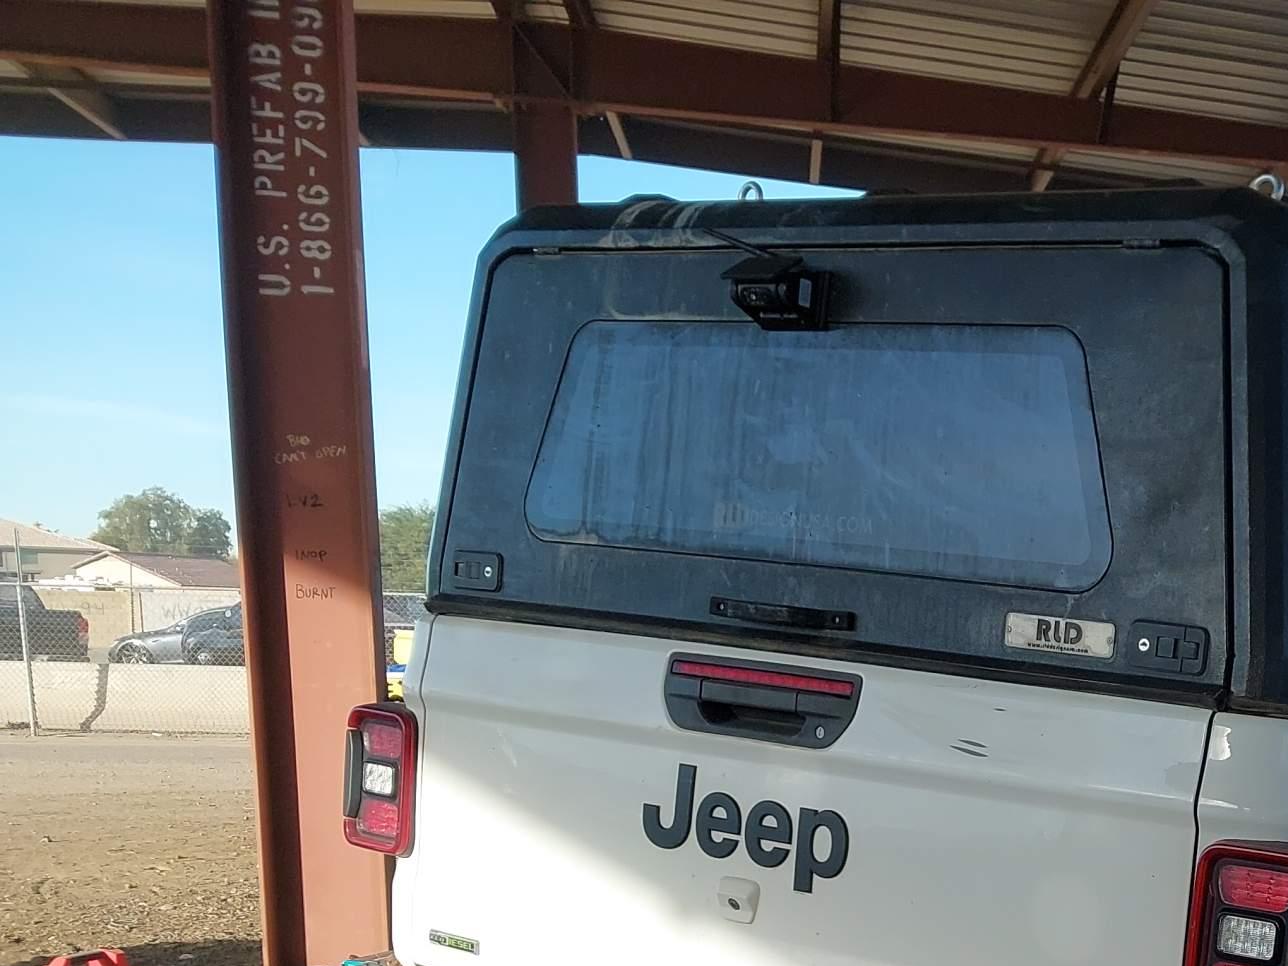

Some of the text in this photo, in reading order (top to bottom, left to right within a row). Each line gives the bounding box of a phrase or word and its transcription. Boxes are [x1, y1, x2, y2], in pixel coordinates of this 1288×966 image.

[248, 42, 287, 197] PREFAB
[289, 0, 334, 294] 1-866-799-09
[257, 223, 291, 297] U.S.
[295, 549, 328, 562] INOP
[295, 583, 336, 600] BURNT
[1036, 618, 1083, 645] RLD
[642, 762, 849, 894] Jeep
